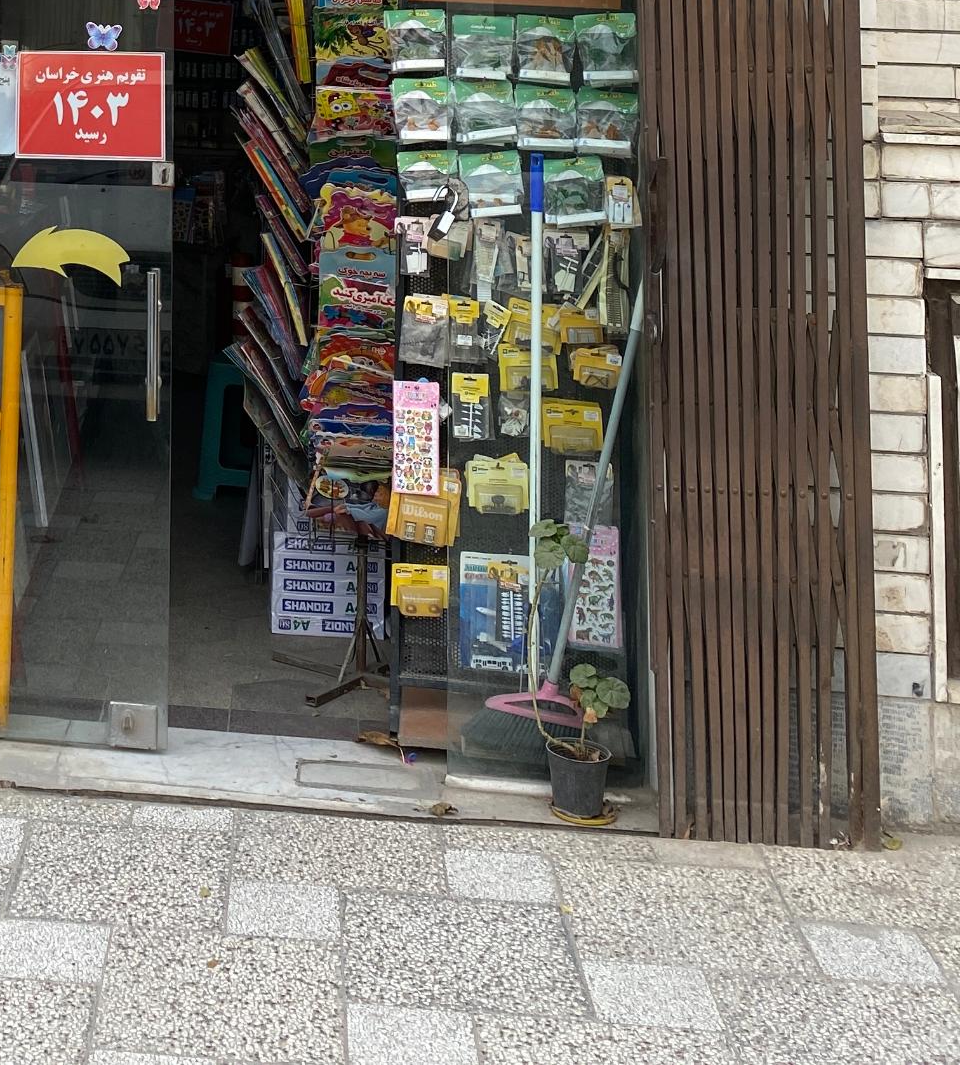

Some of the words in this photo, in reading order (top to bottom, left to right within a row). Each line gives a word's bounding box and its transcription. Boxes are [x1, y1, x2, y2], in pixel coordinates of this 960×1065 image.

[35, 66, 80, 84] خراسان
[116, 68, 147, 86] تقویم
[53, 89, 129, 127] ۱۴۰۳
[74, 128, 108, 145] رسید
[401, 504, 444, 522] Wilson
[286, 560, 332, 572] SHANDIZ
[286, 580, 332, 592] SHANDIZ
[285, 601, 331, 613] SHANDIZ
